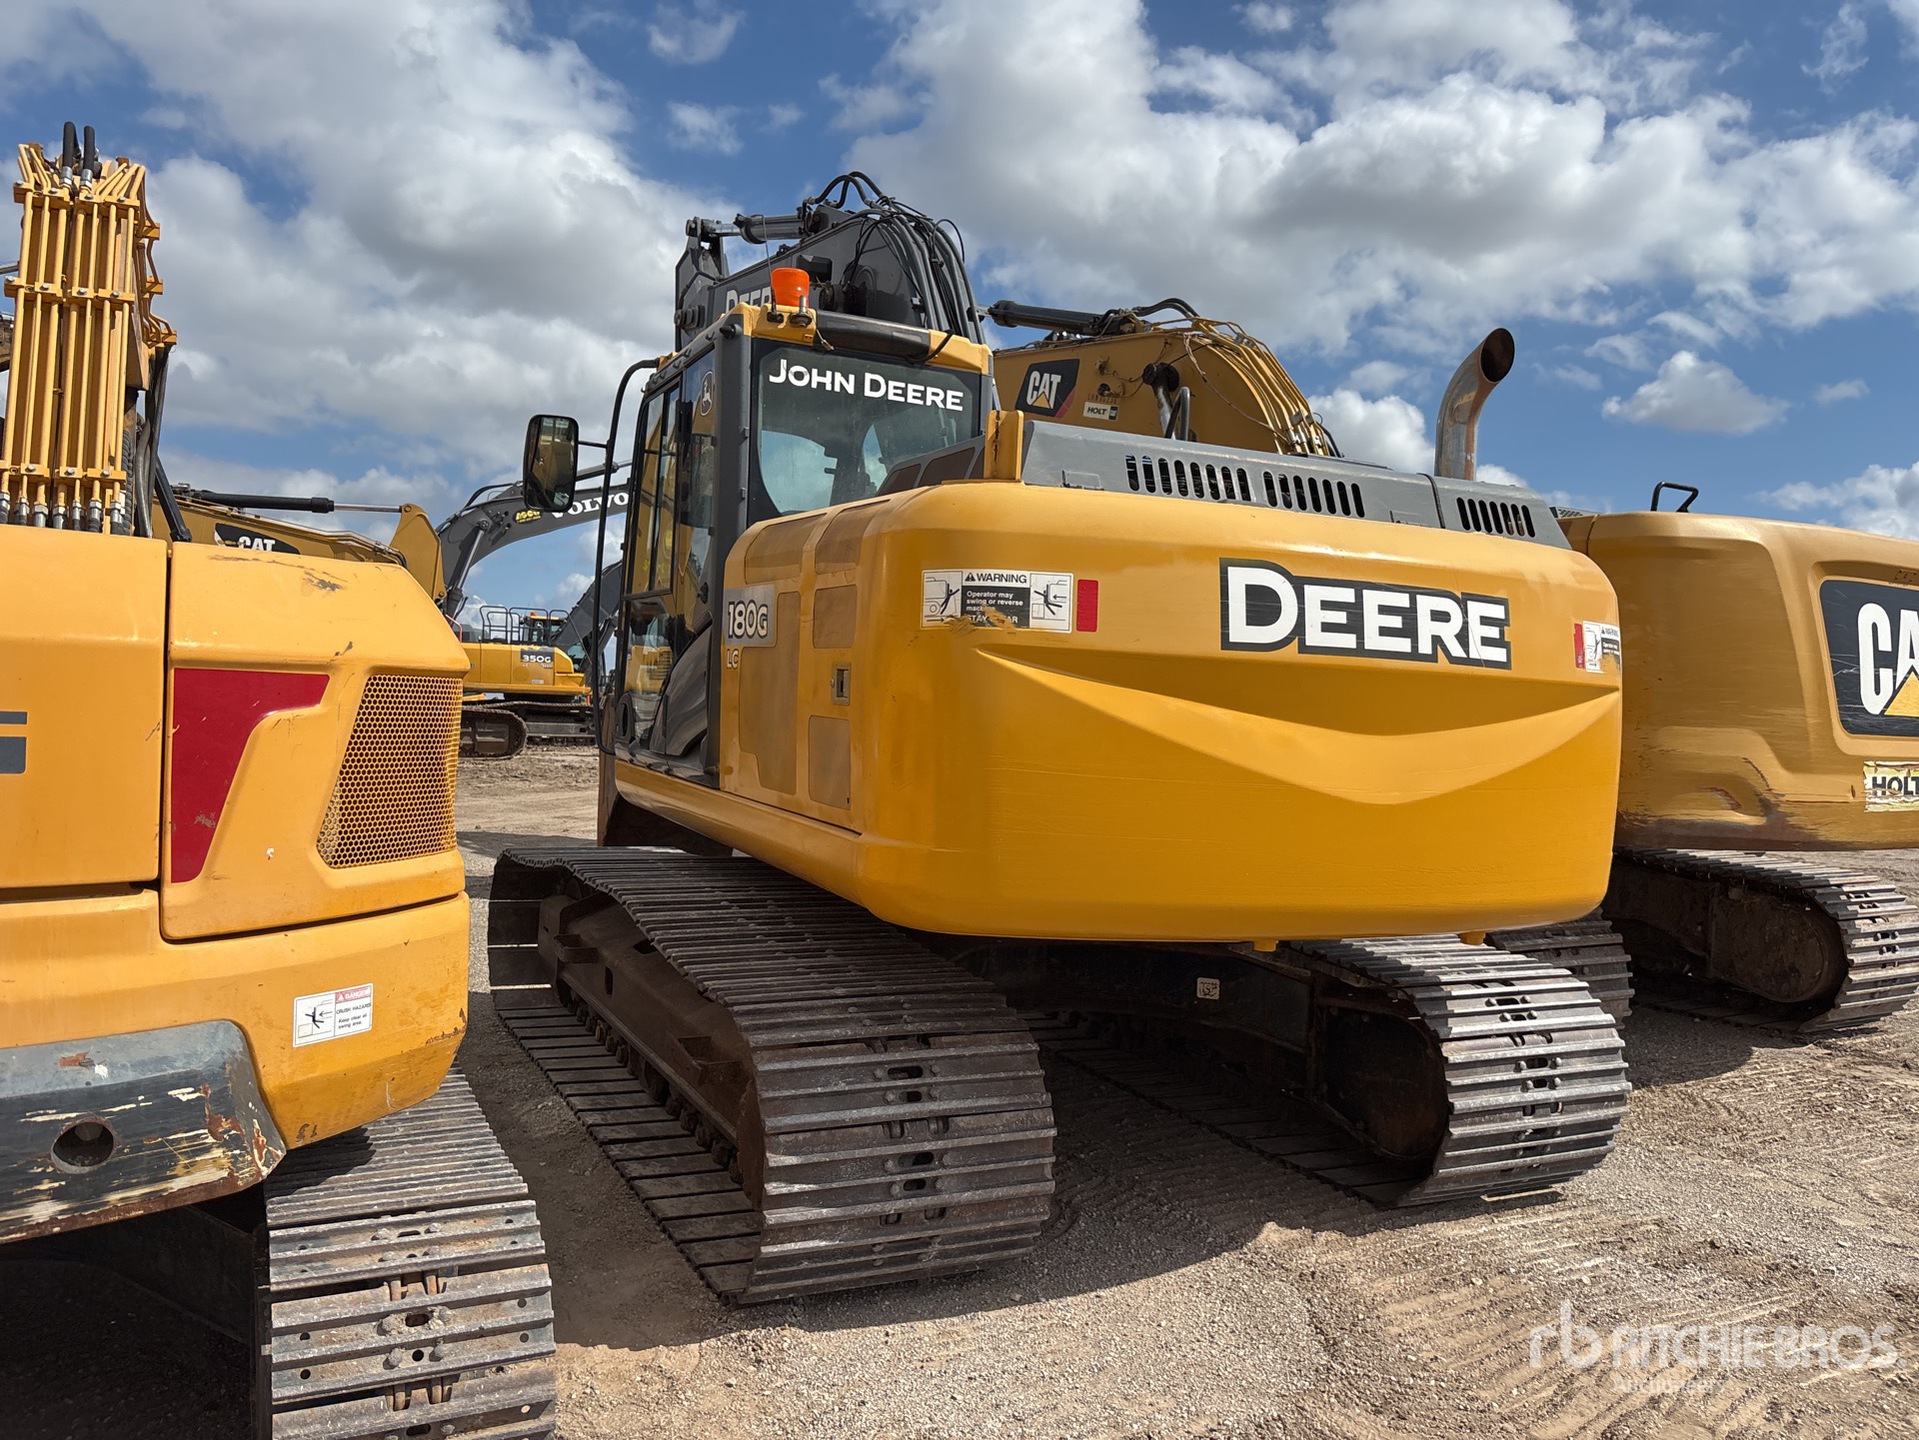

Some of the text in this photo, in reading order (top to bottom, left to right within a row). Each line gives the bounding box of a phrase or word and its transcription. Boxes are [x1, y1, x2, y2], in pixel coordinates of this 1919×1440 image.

[769, 358, 964, 411] JOHN DEERE
[1026, 370, 1062, 409] CAT
[1087, 406, 1108, 416] HOLT
[976, 573, 1027, 584] WARNING
[966, 590, 997, 599] Operator
[727, 599, 769, 639] 180G
[1227, 566, 1507, 663] DEERE
[522, 654, 552, 663] 350G
[726, 648, 739, 669] LC
[1857, 602, 1919, 716] CA
